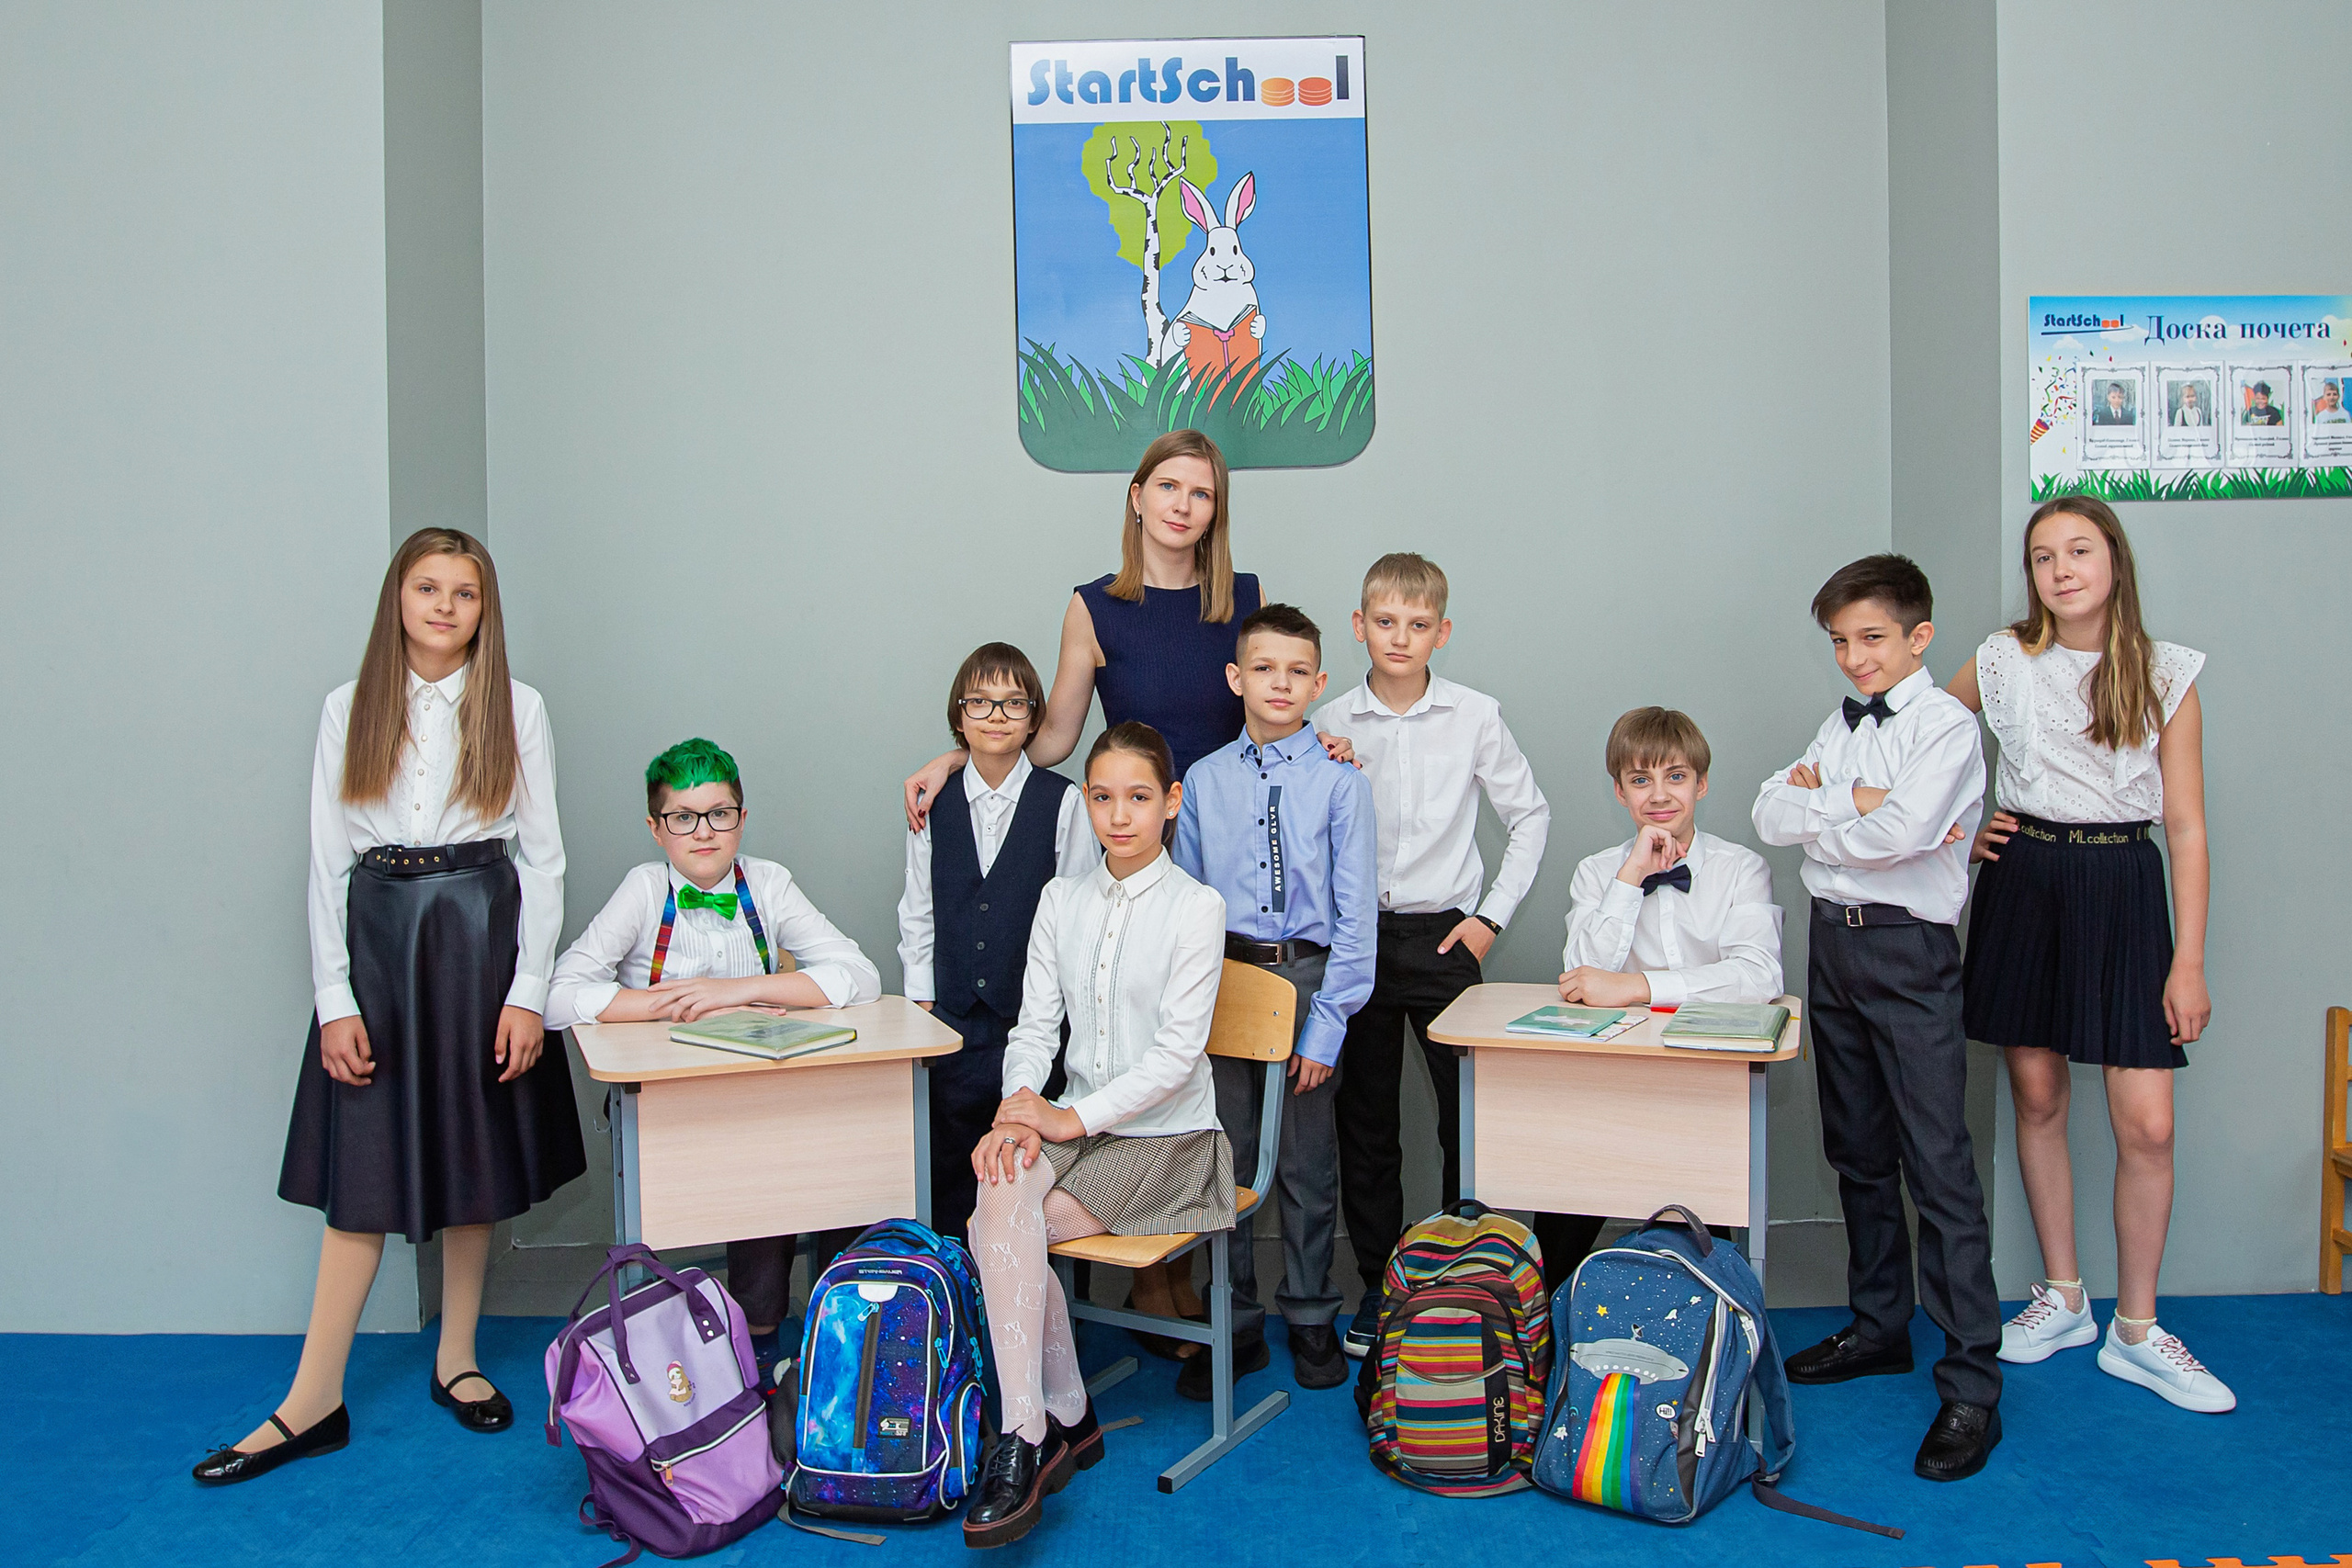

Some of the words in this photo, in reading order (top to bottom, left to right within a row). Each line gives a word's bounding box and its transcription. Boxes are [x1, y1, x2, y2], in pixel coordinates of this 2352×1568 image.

[2143, 315, 2228, 346] Доска
[2240, 321, 2331, 340] почета
[1272, 840, 1282, 892] AWESOME
[1493, 1396, 1506, 1443] DAKINE
